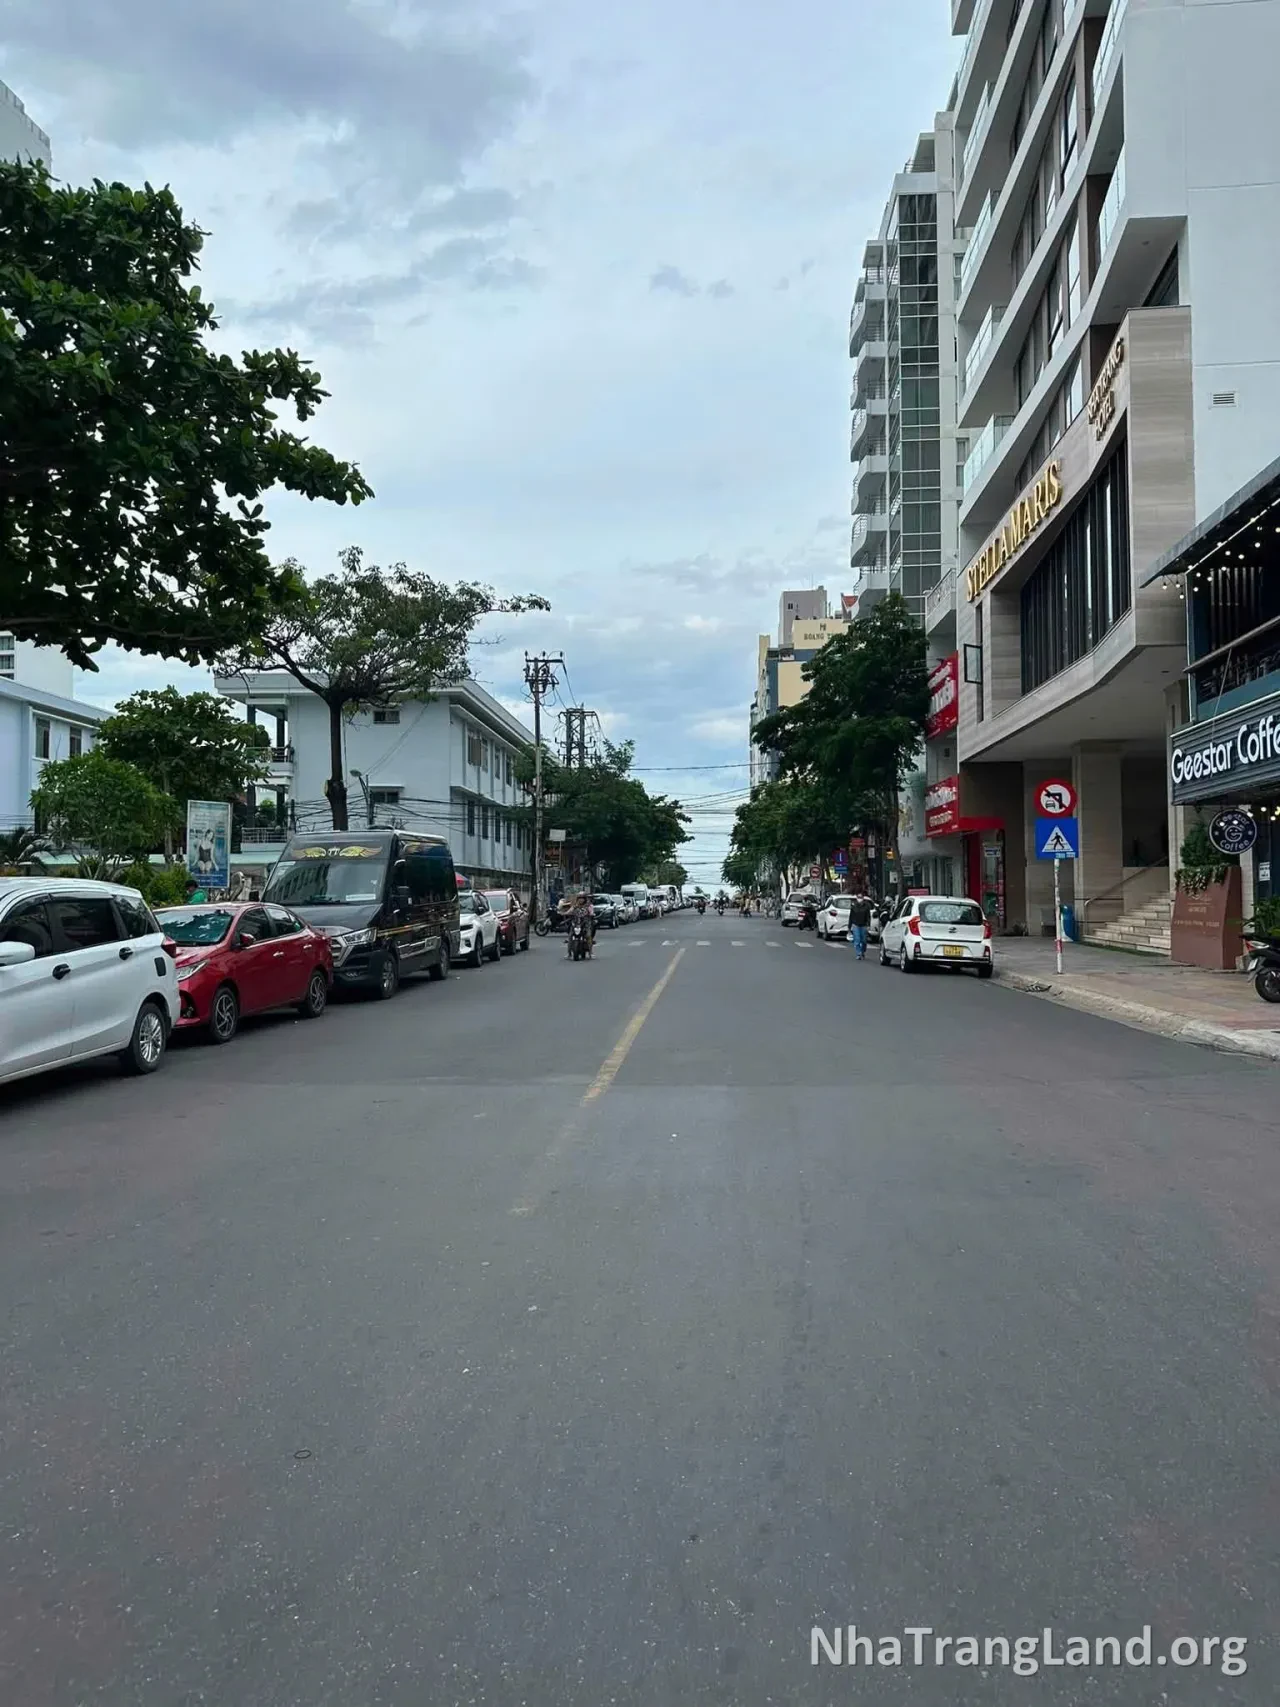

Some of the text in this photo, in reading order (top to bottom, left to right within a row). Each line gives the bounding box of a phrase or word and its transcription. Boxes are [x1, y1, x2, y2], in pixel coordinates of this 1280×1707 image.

[966, 460, 1063, 602] STELLA MARIS
[1171, 740, 1233, 784] Geestar
[1219, 839, 1250, 851] Coffee
